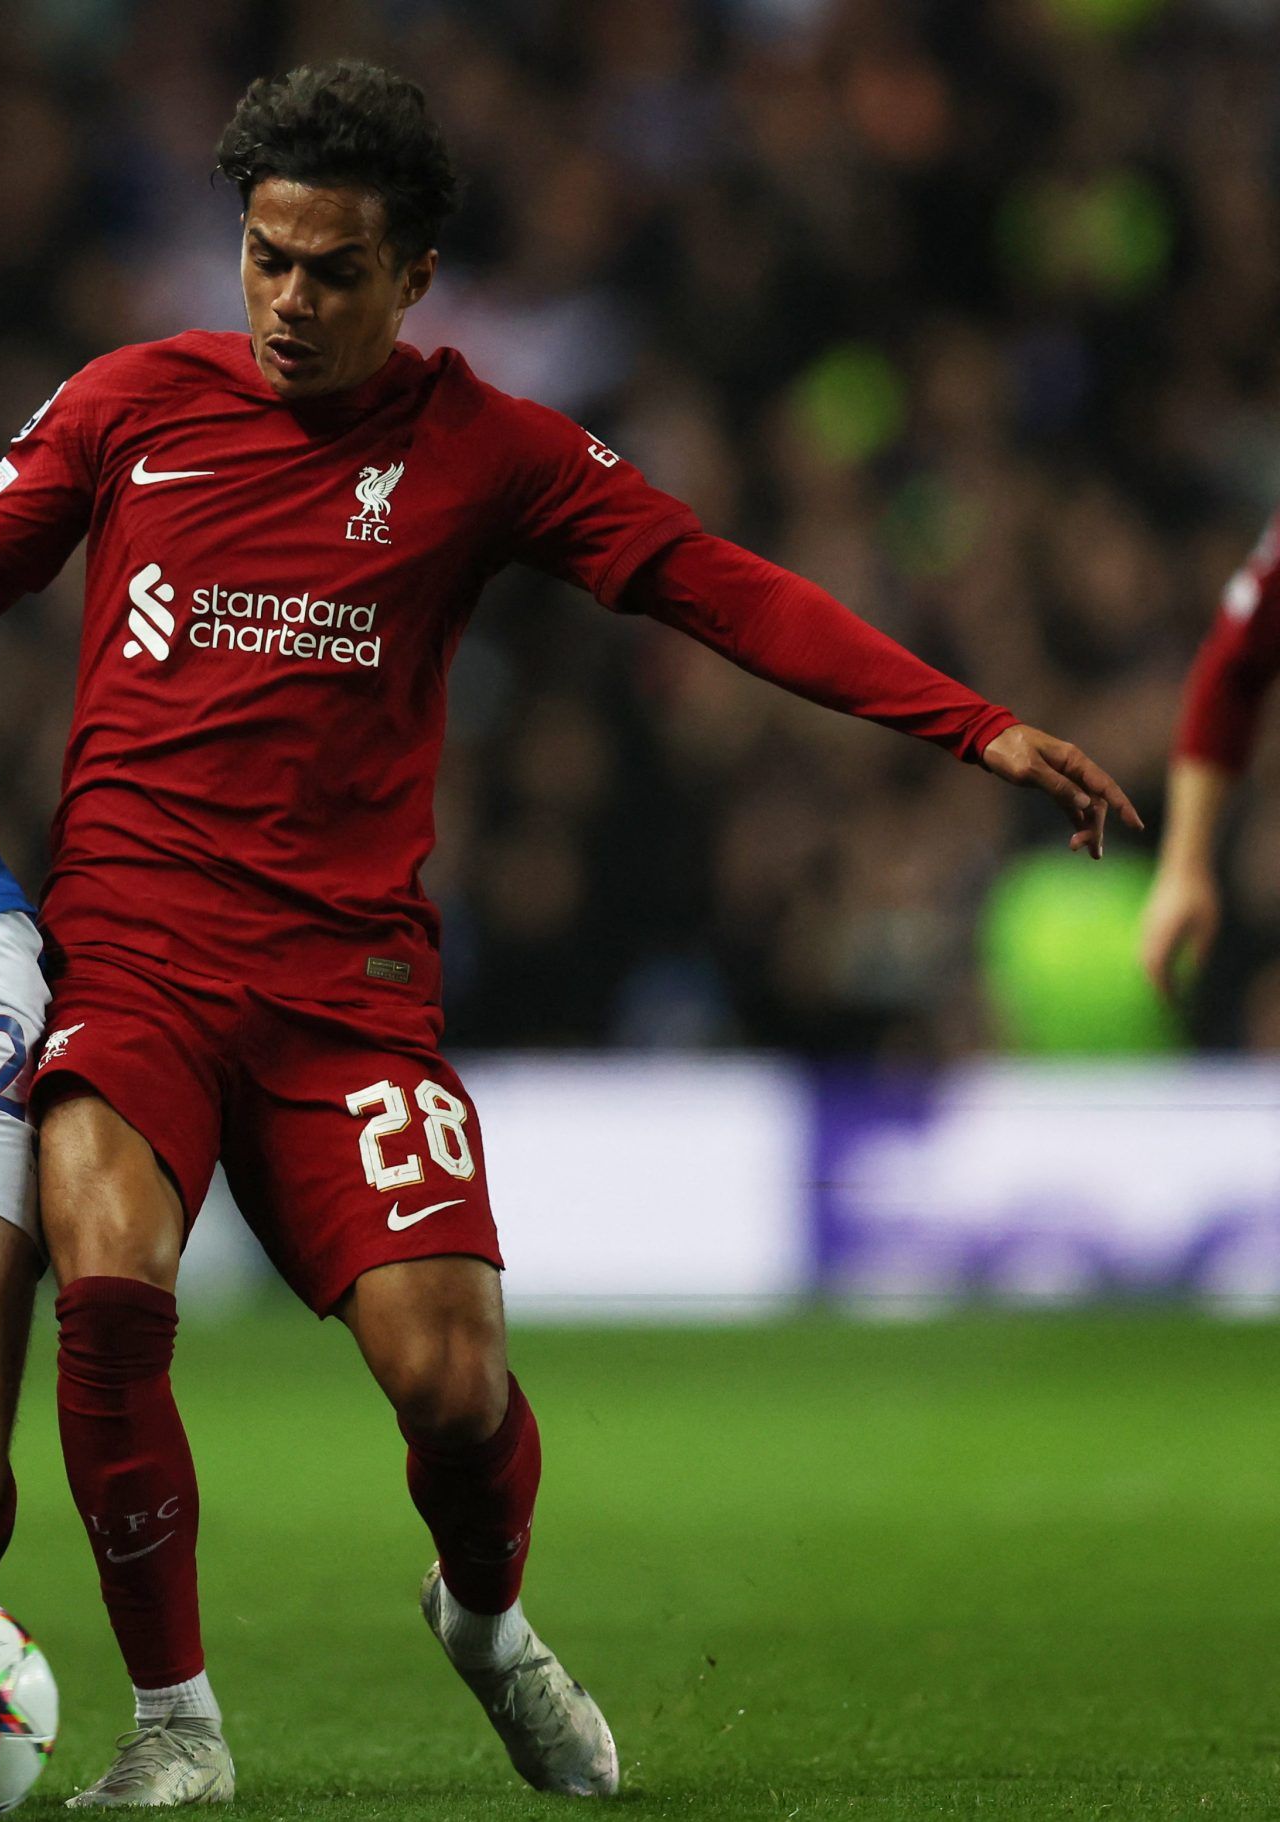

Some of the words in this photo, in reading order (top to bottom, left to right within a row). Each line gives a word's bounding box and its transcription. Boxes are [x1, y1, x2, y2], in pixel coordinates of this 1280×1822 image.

[191, 583, 377, 632] standard
[189, 617, 381, 667] chartered
[345, 1079, 475, 1192] 28
